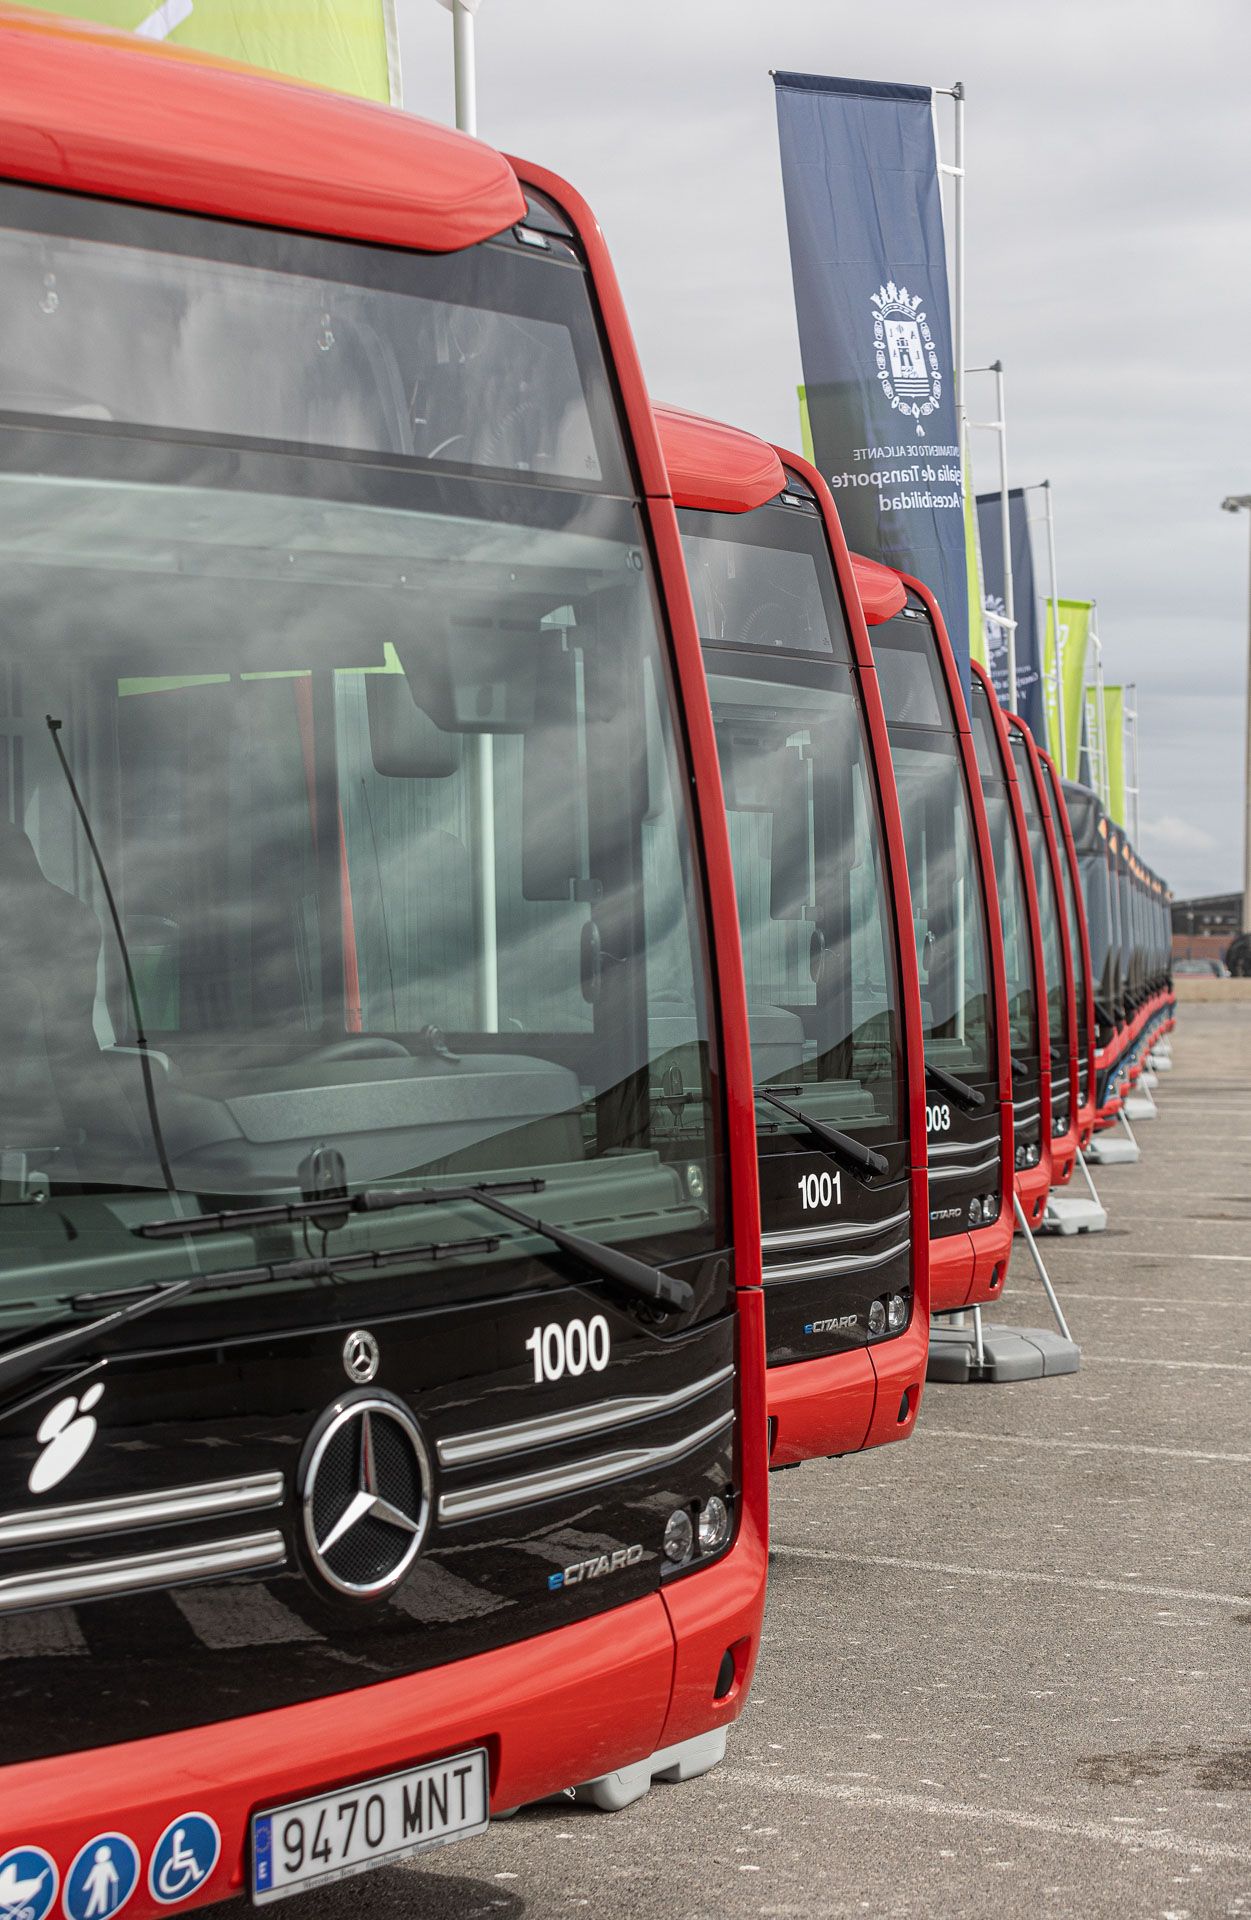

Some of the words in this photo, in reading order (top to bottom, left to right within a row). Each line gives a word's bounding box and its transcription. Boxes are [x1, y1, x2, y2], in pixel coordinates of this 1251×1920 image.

[797, 1170, 842, 1210] 1001
[525, 1314, 611, 1384] 1000
[258, 1861, 268, 1880] E
[283, 1794, 385, 1873] 9470
[403, 1765, 472, 1838] MNT
